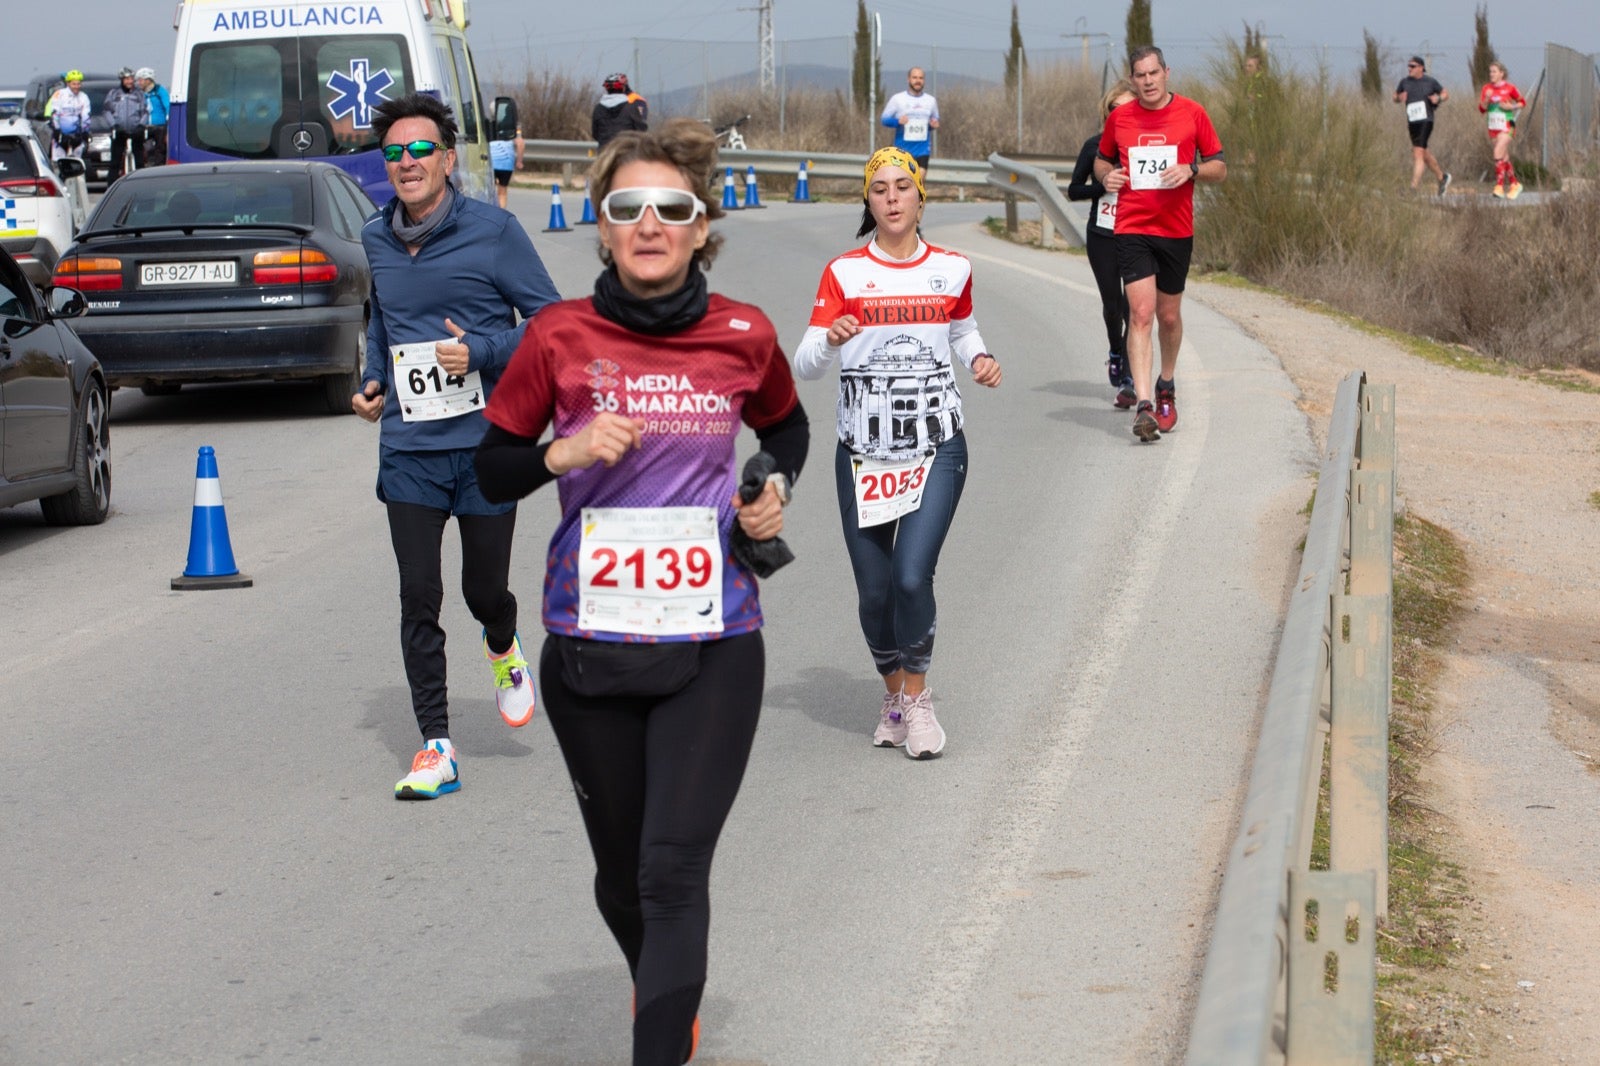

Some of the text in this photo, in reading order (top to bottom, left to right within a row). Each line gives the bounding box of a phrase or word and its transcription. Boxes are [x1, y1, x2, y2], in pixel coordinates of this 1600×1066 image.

[213, 6, 383, 31] AMBULANCIA
[1137, 159, 1168, 175] 734
[144, 263, 233, 282] GR-9271-AU
[88, 301, 121, 309] RENAULT
[260, 294, 293, 304] Laguna
[863, 296, 946, 307] XVI MEDIA MARATÓN
[408, 365, 466, 395] 614
[625, 374, 695, 392] MEDIA
[591, 391, 619, 413] 36
[626, 389, 732, 413] MARATÓN
[637, 420, 700, 434] ORDOBA
[861, 466, 926, 502] 2053
[590, 546, 713, 590] 2139
